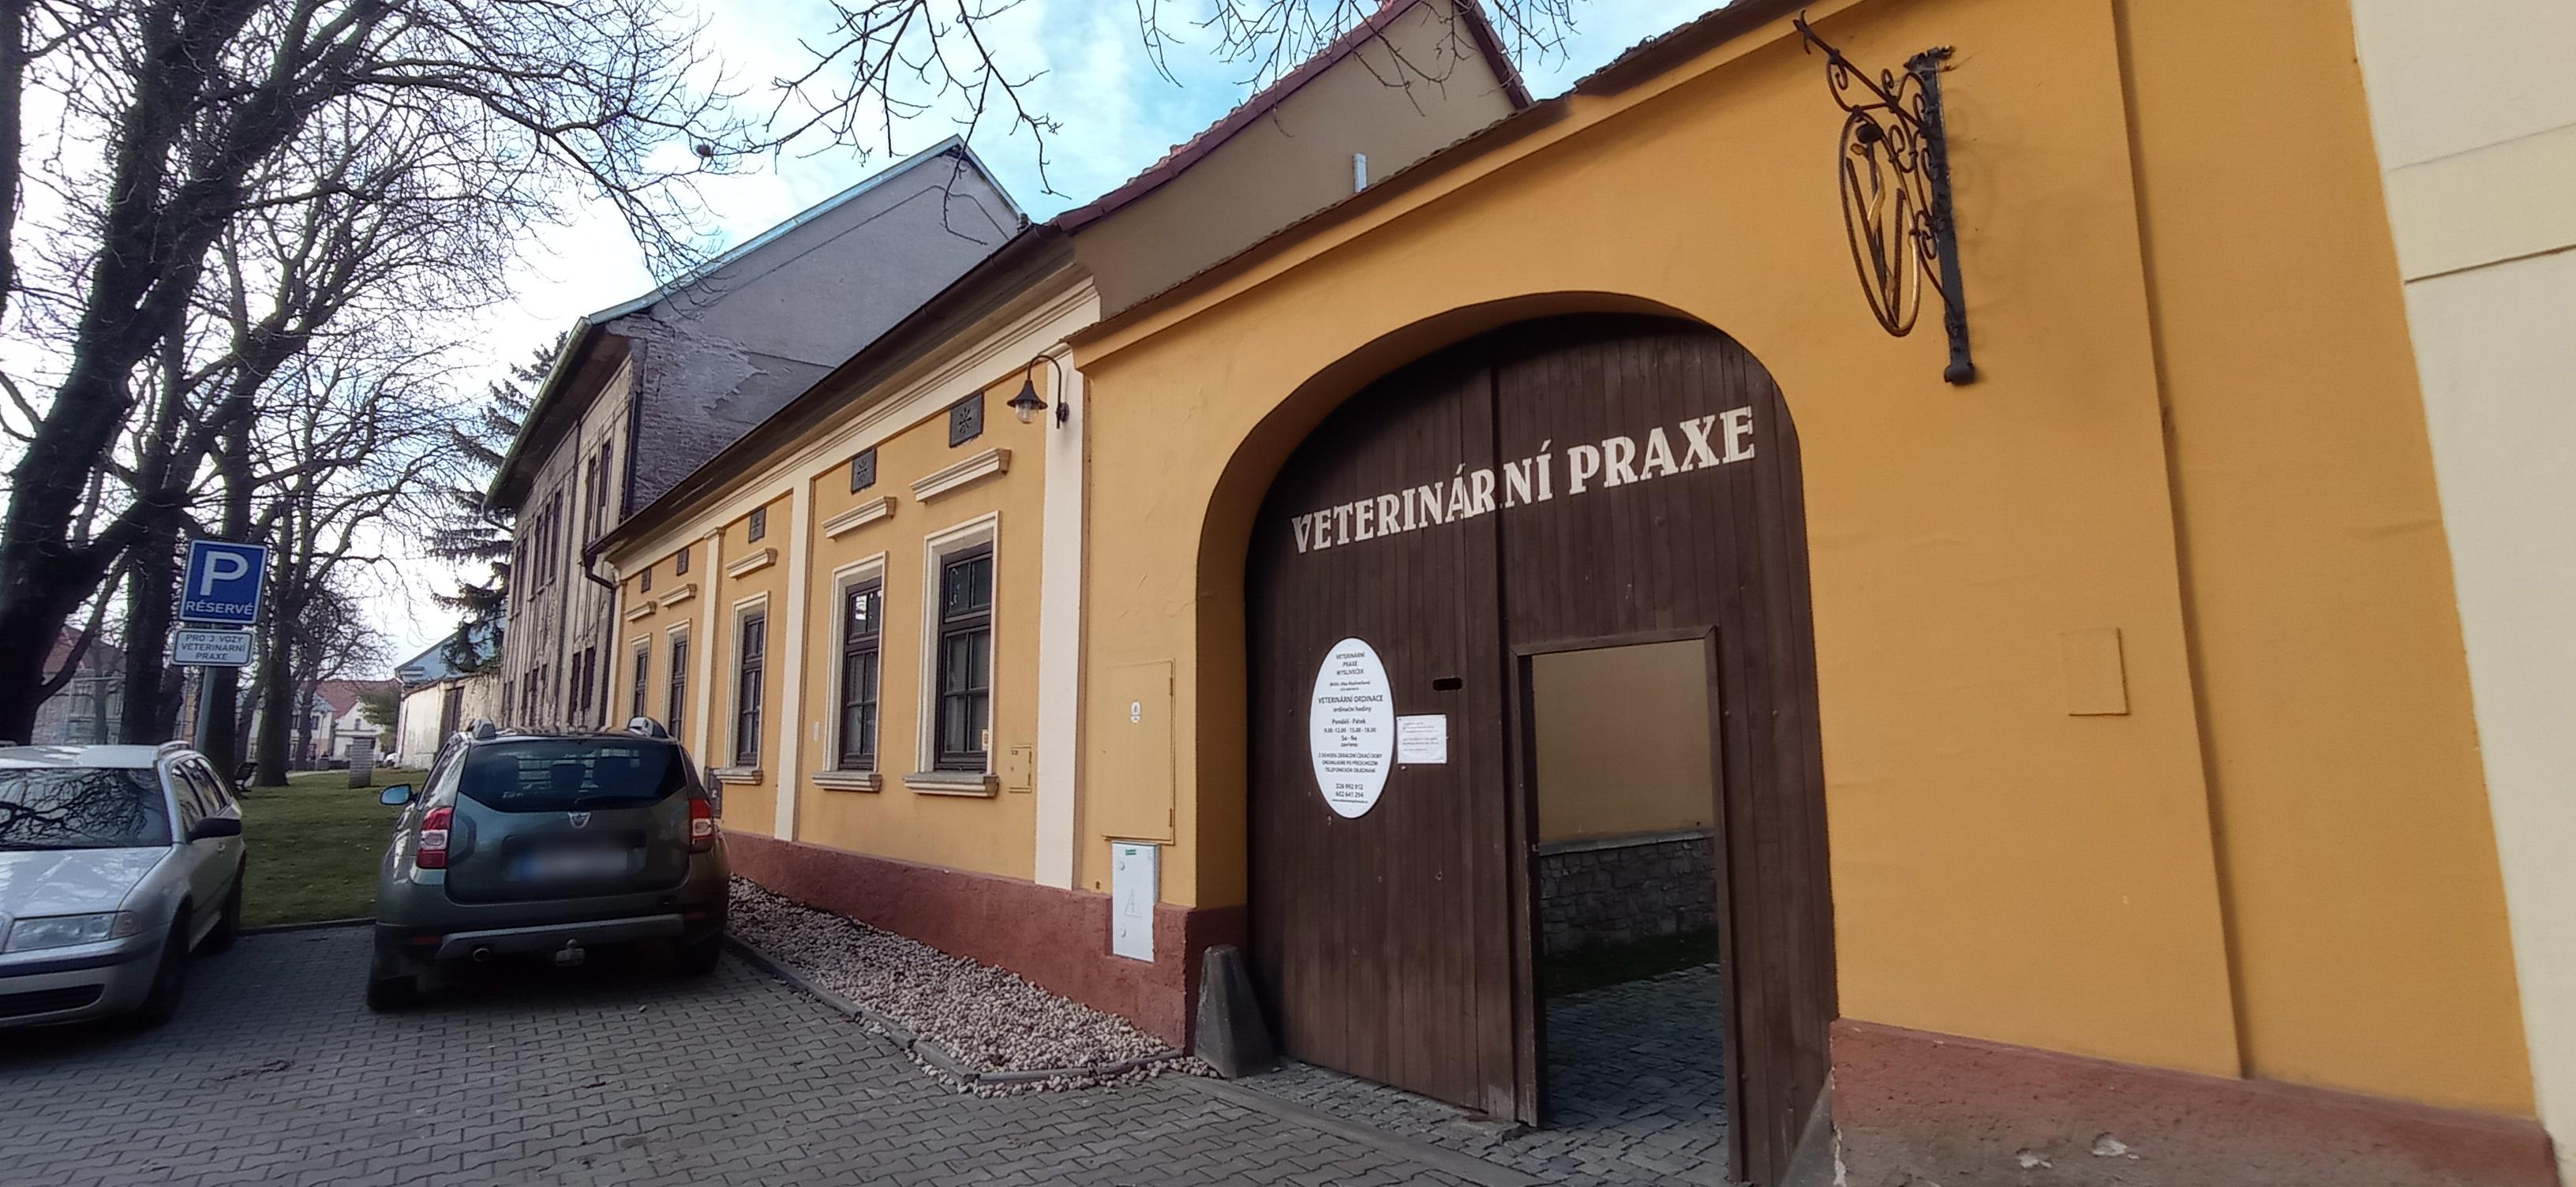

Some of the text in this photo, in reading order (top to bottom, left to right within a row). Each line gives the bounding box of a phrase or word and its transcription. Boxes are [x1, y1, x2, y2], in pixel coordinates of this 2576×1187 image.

[1290, 406, 1755, 554] VETERINÁRNÍ PRAXE
[200, 550, 249, 597] P
[185, 599, 253, 615] RÉSERVÉ
